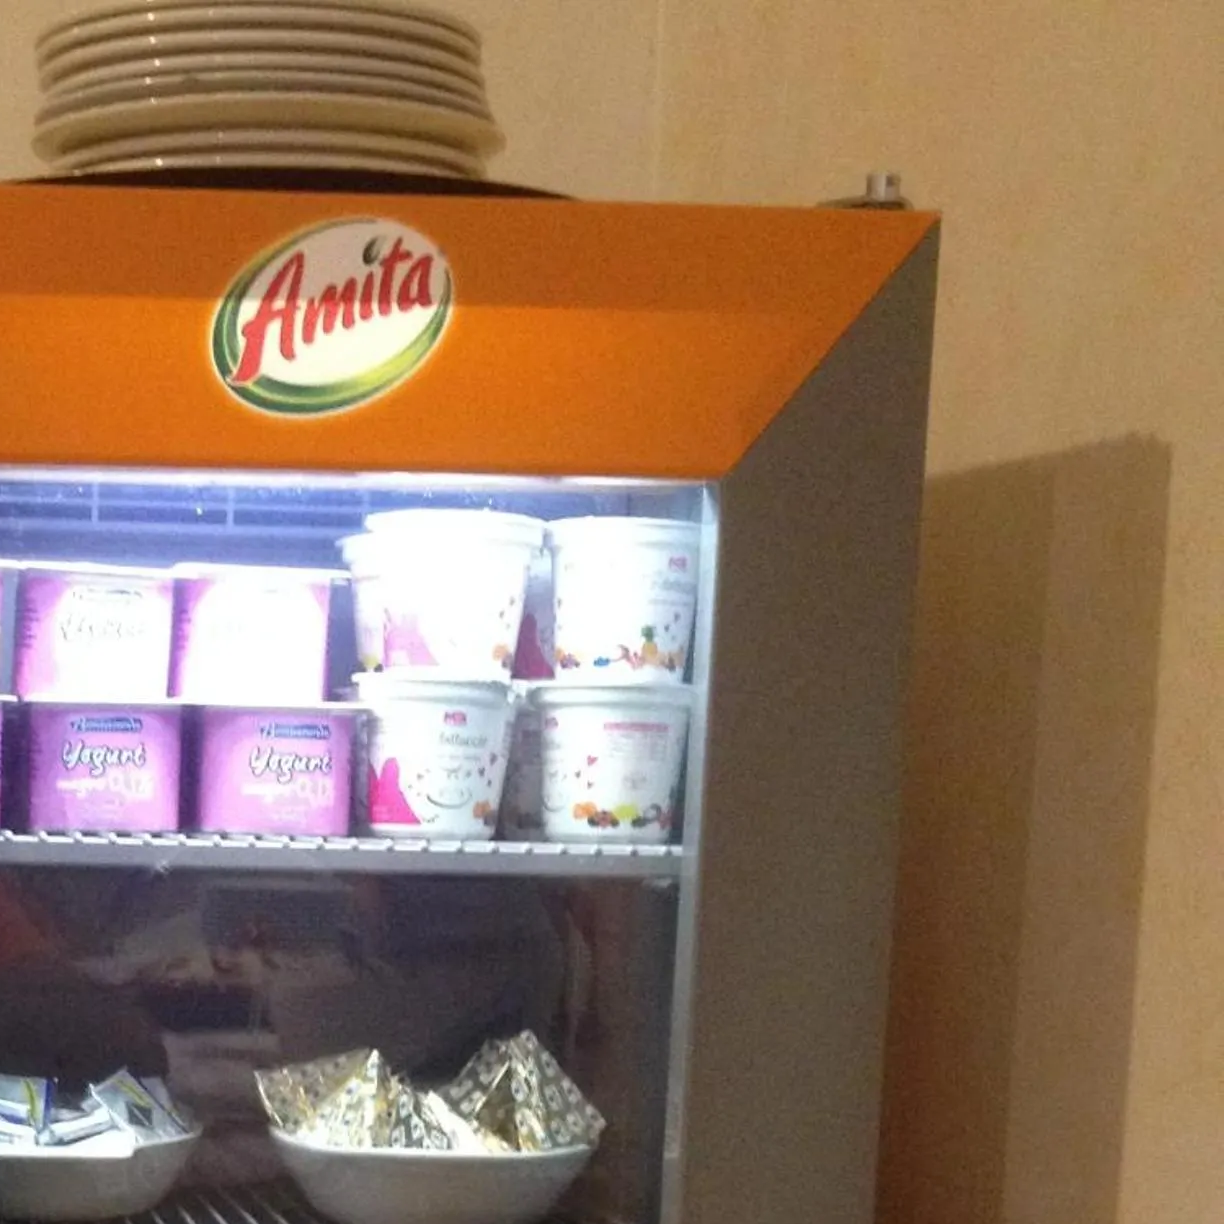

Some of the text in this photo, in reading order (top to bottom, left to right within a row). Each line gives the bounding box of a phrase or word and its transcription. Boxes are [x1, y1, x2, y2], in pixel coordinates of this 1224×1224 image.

[230, 236, 433, 383] Amita
[61, 738, 147, 777] Yogurt
[249, 745, 333, 785] Yogurt
